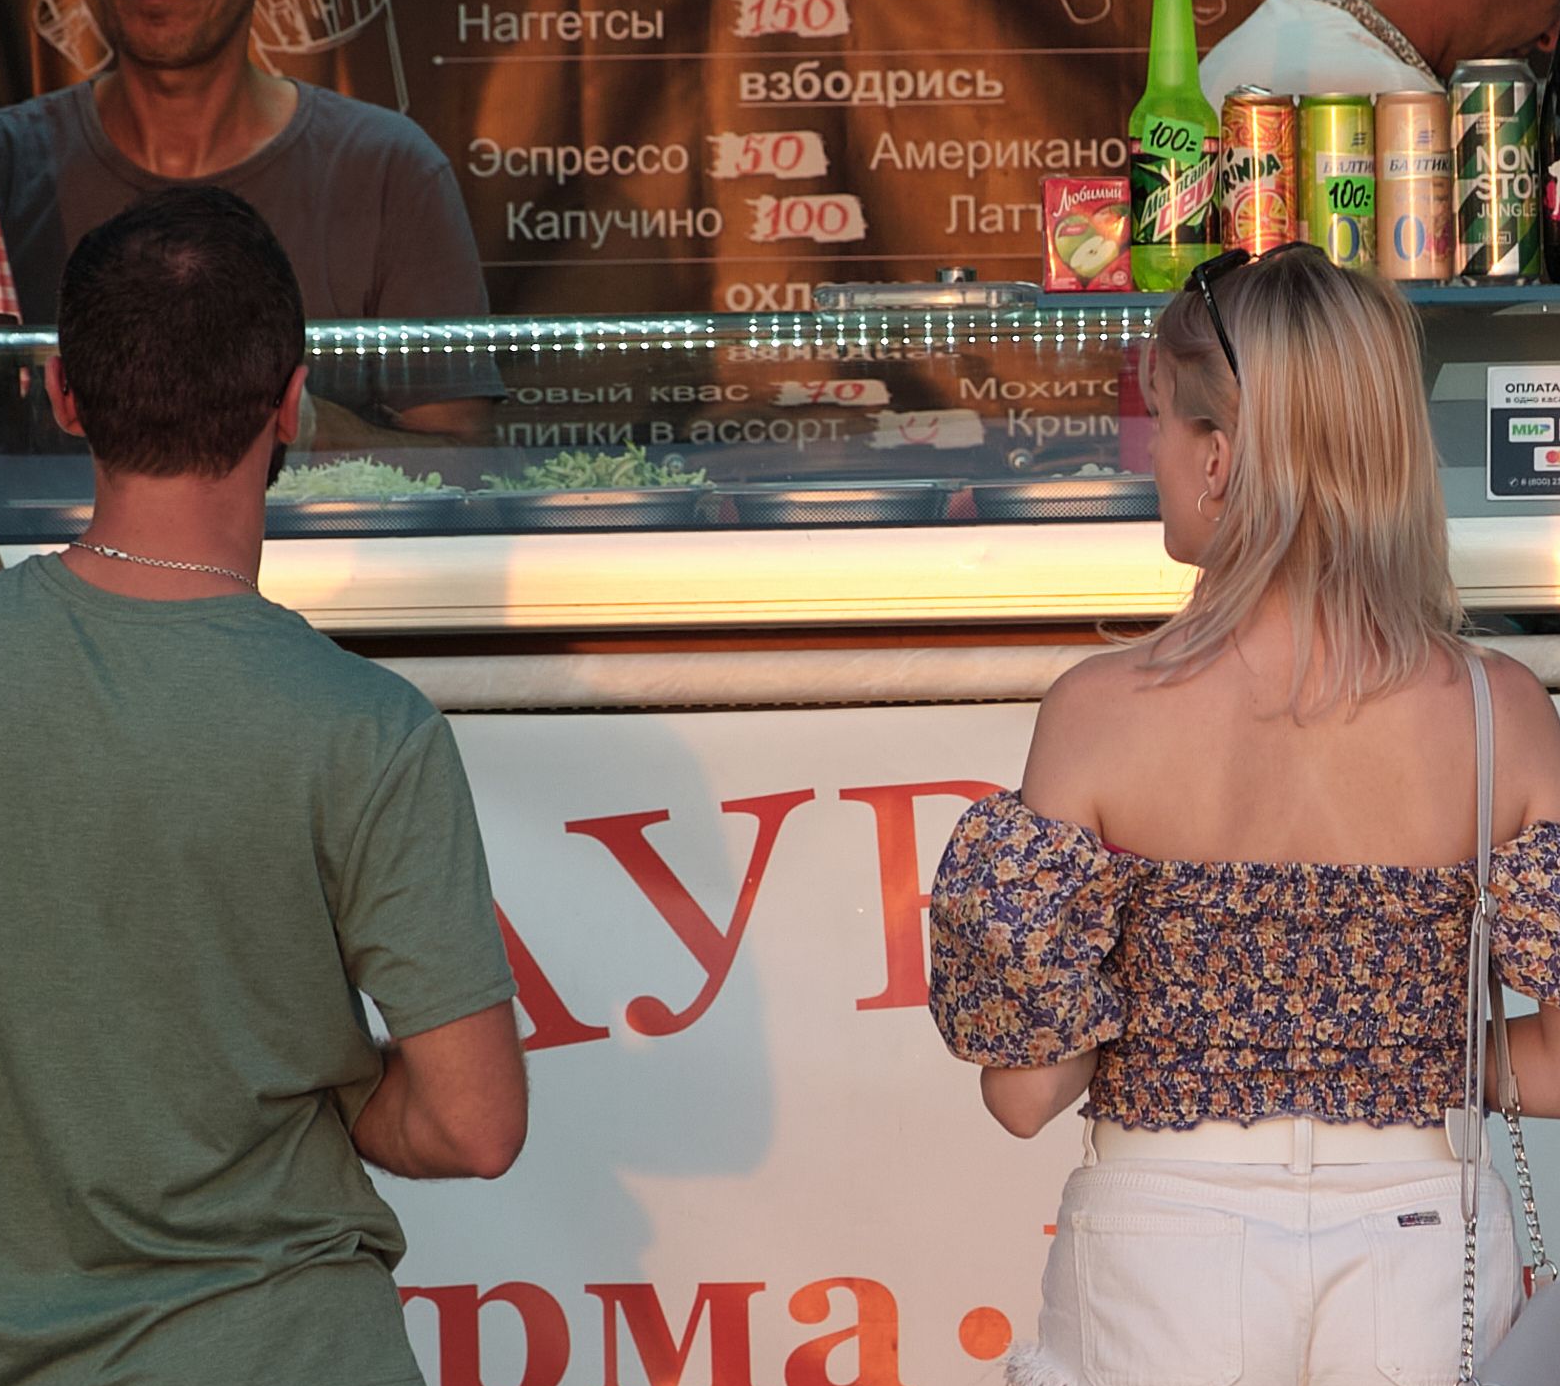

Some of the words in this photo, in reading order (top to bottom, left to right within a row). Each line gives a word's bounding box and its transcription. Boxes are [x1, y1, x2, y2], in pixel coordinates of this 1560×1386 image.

[457, 6, 663, 42] Наггетсы
[739, 64, 1003, 103] взбодрись
[468, 140, 688, 183] Эспрессо
[733, 136, 806, 175] 50
[870, 132, 1127, 179] Американо
[1476, 144, 1536, 173] NON
[1053, 184, 1123, 217] Любимый
[507, 204, 722, 251] Капучино
[760, 201, 852, 236] 100
[651, 385, 750, 403] квас
[1505, 382, 1560, 394] ОПЛАТА
[651, 422, 674, 444] в
[691, 418, 851, 451] ассорт.
[1511, 423, 1551, 435] МИР
